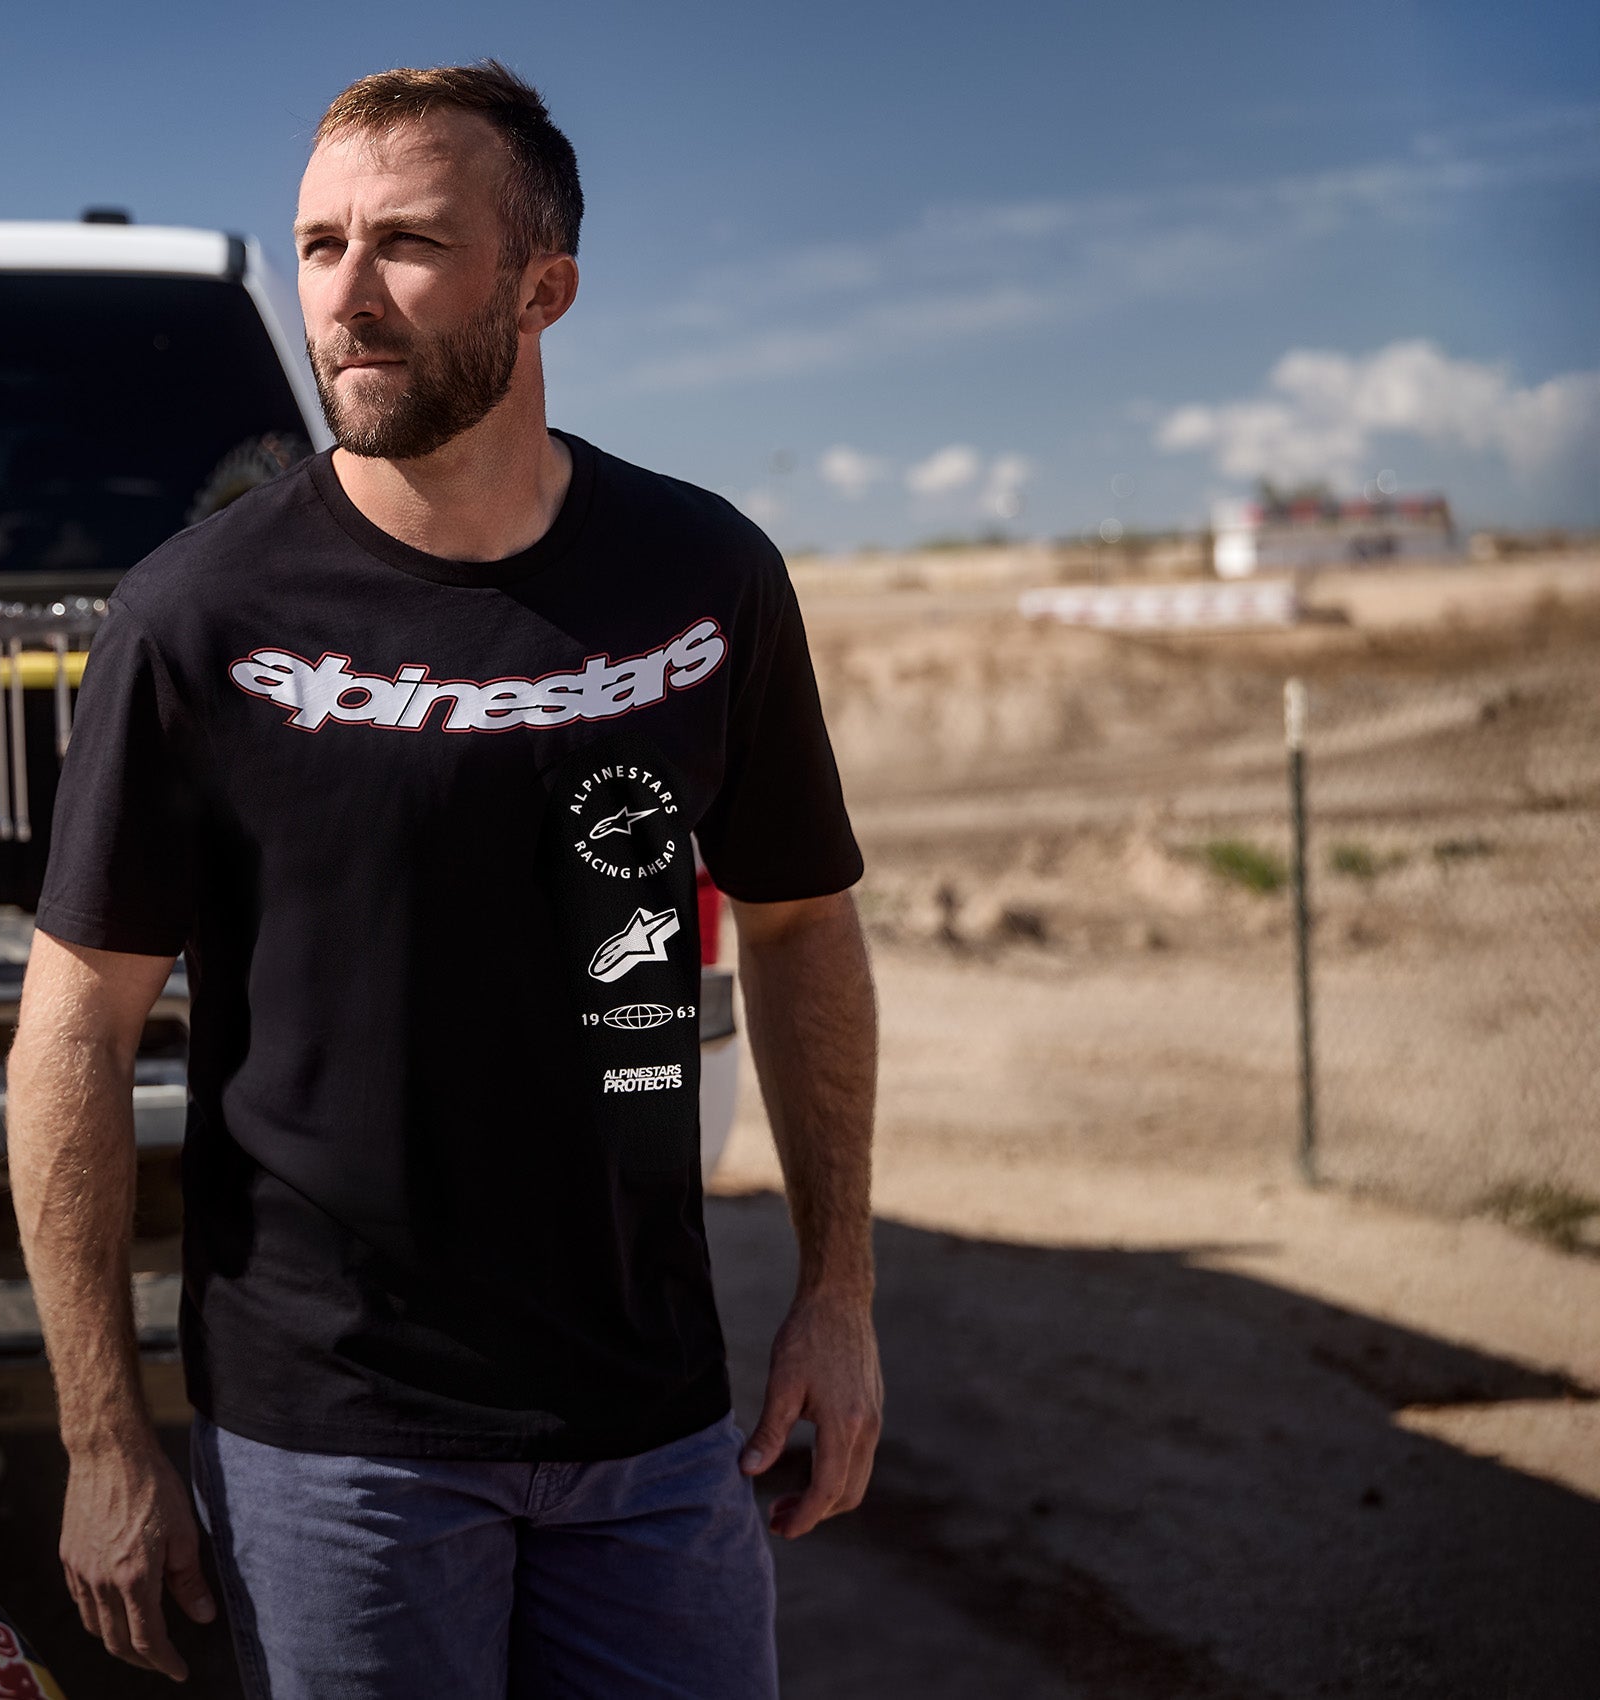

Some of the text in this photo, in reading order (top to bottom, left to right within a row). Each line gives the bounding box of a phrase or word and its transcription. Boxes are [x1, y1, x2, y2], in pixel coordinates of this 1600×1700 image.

[228, 617, 728, 733] alpinestars
[570, 765, 678, 815] ALPINESTARS
[574, 840, 676, 879] RACING AHEAD
[581, 1005, 696, 1026] 19 63
[603, 1064, 682, 1081] ALPINESTARS
[603, 1075, 683, 1093] PROTECTS
